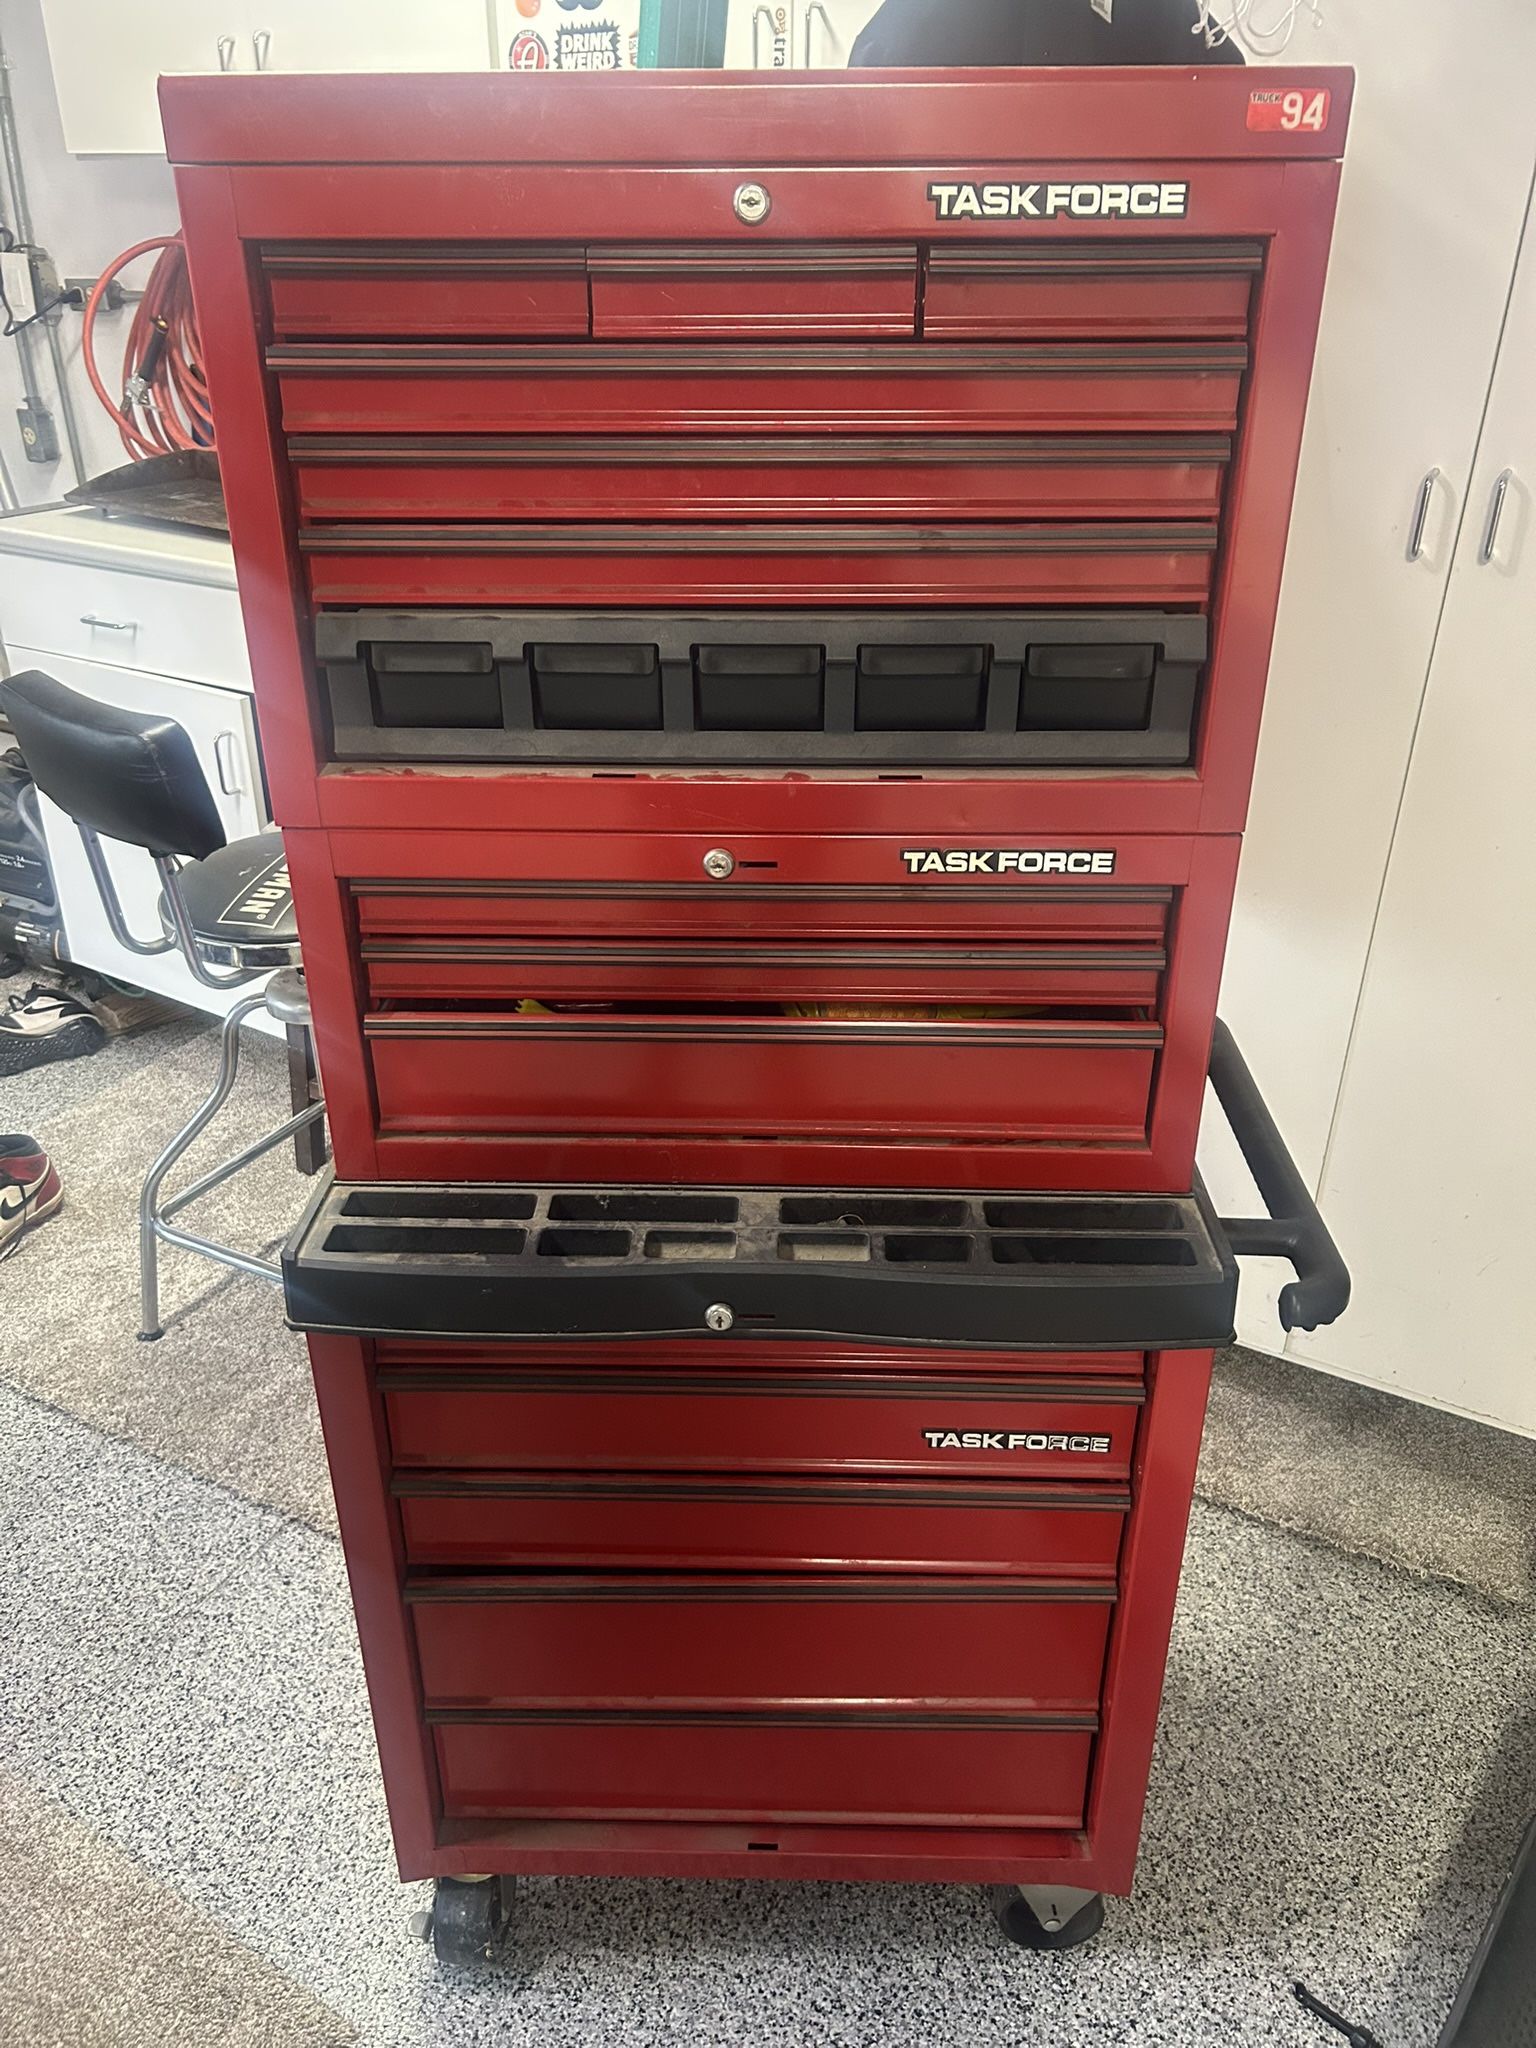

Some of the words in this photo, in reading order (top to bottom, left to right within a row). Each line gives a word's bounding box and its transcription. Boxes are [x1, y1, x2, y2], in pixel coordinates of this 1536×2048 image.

[561, 31, 616, 53] DRINK
[561, 51, 616, 69] WEIRD
[1252, 92, 1281, 103] TRUCK
[1281, 91, 1325, 131] 94
[932, 185, 1040, 215] TASK
[1046, 184, 1187, 215] FORCE
[904, 851, 995, 873] TASK
[999, 852, 1114, 873] FORCE
[925, 1432, 1004, 1449] TASK
[1008, 1434, 1111, 1453] FORCE
